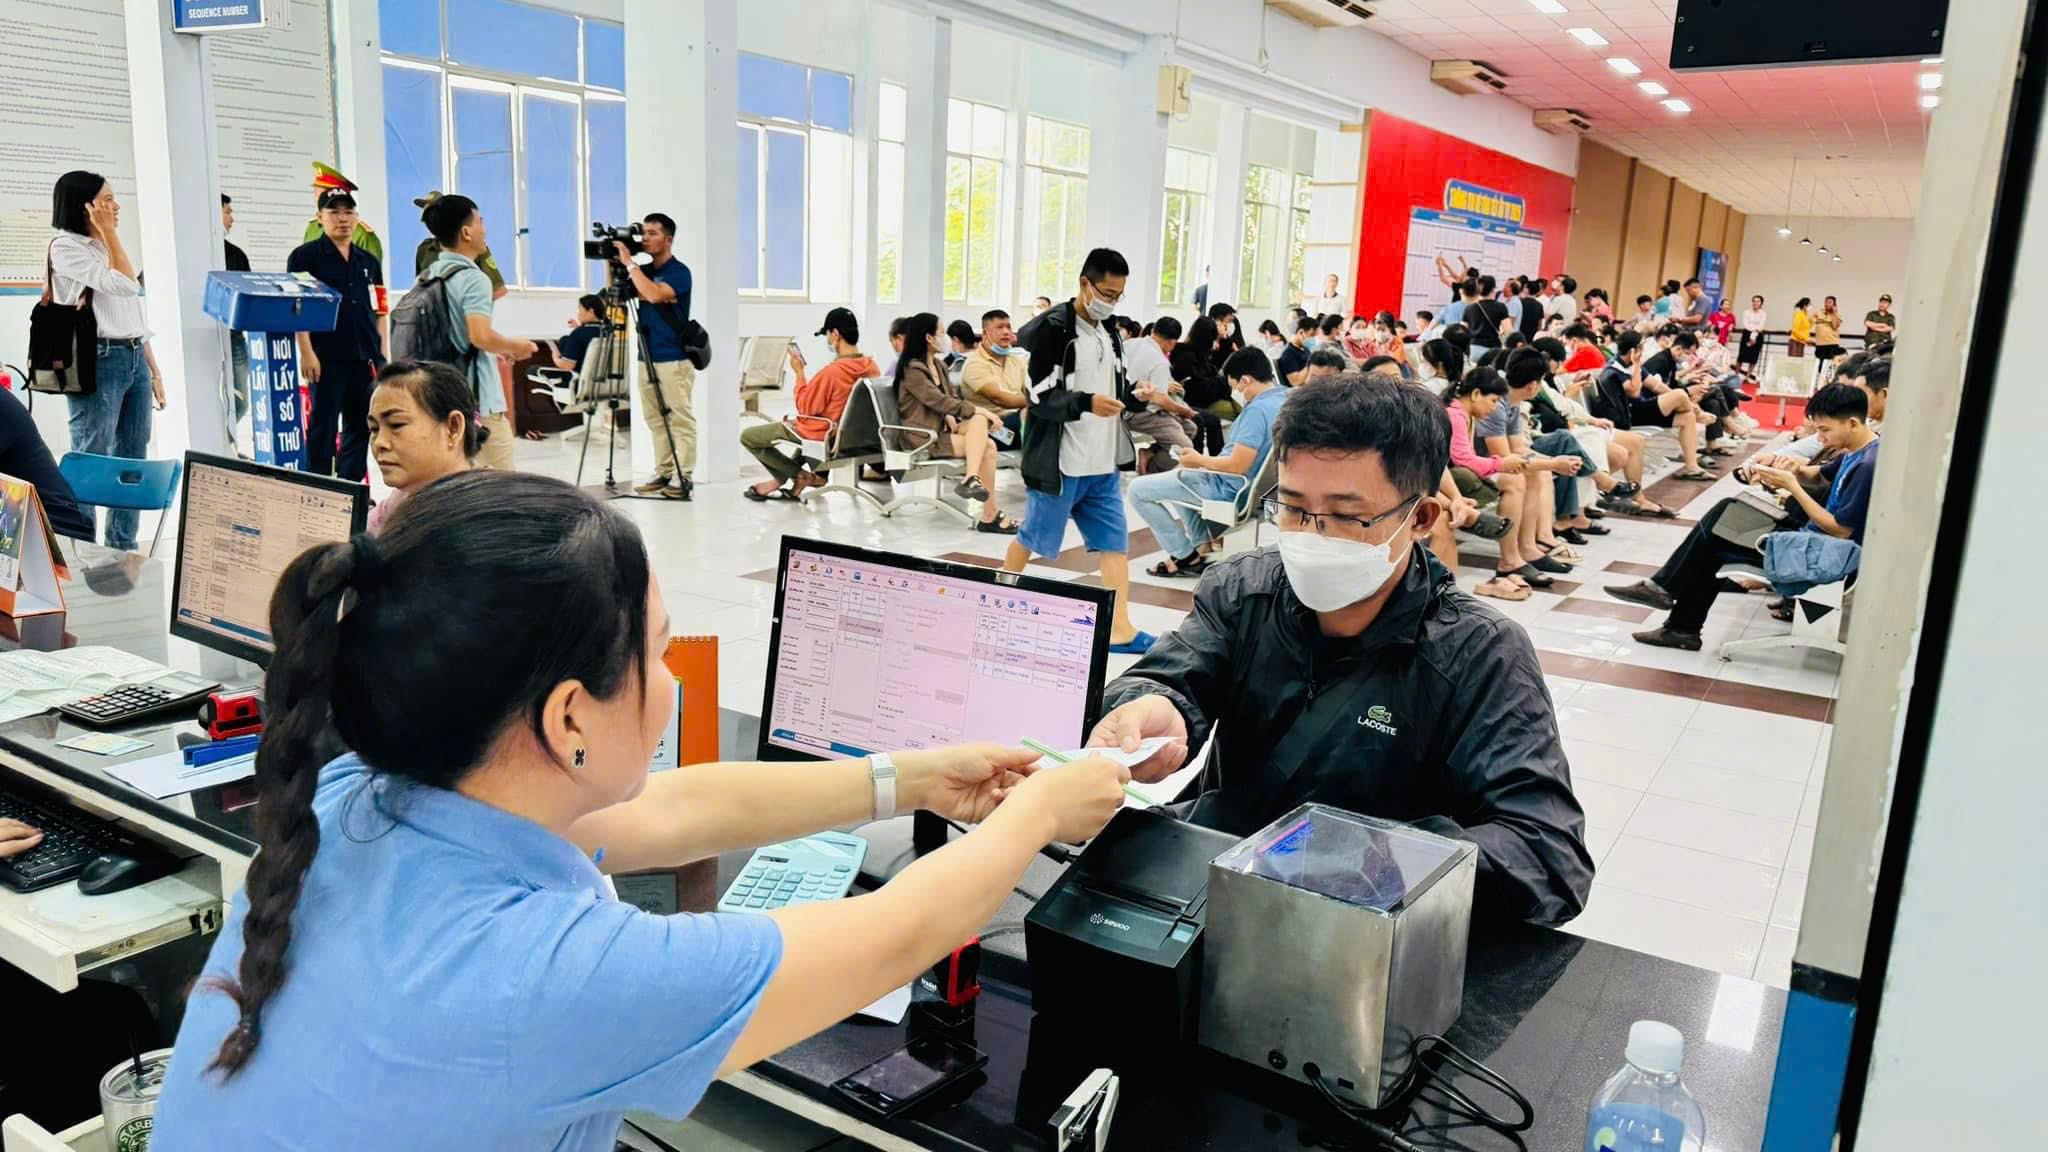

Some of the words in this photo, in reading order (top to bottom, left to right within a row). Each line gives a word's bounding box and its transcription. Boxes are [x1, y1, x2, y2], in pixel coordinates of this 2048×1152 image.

[188, 7, 221, 19] SEQUENCE
[222, 5, 249, 17] NUMBER
[272, 336, 292, 360] NƠI
[274, 363, 295, 391] LẤY
[280, 393, 295, 421] SỐ
[1357, 715, 1398, 736] LACOSTE
